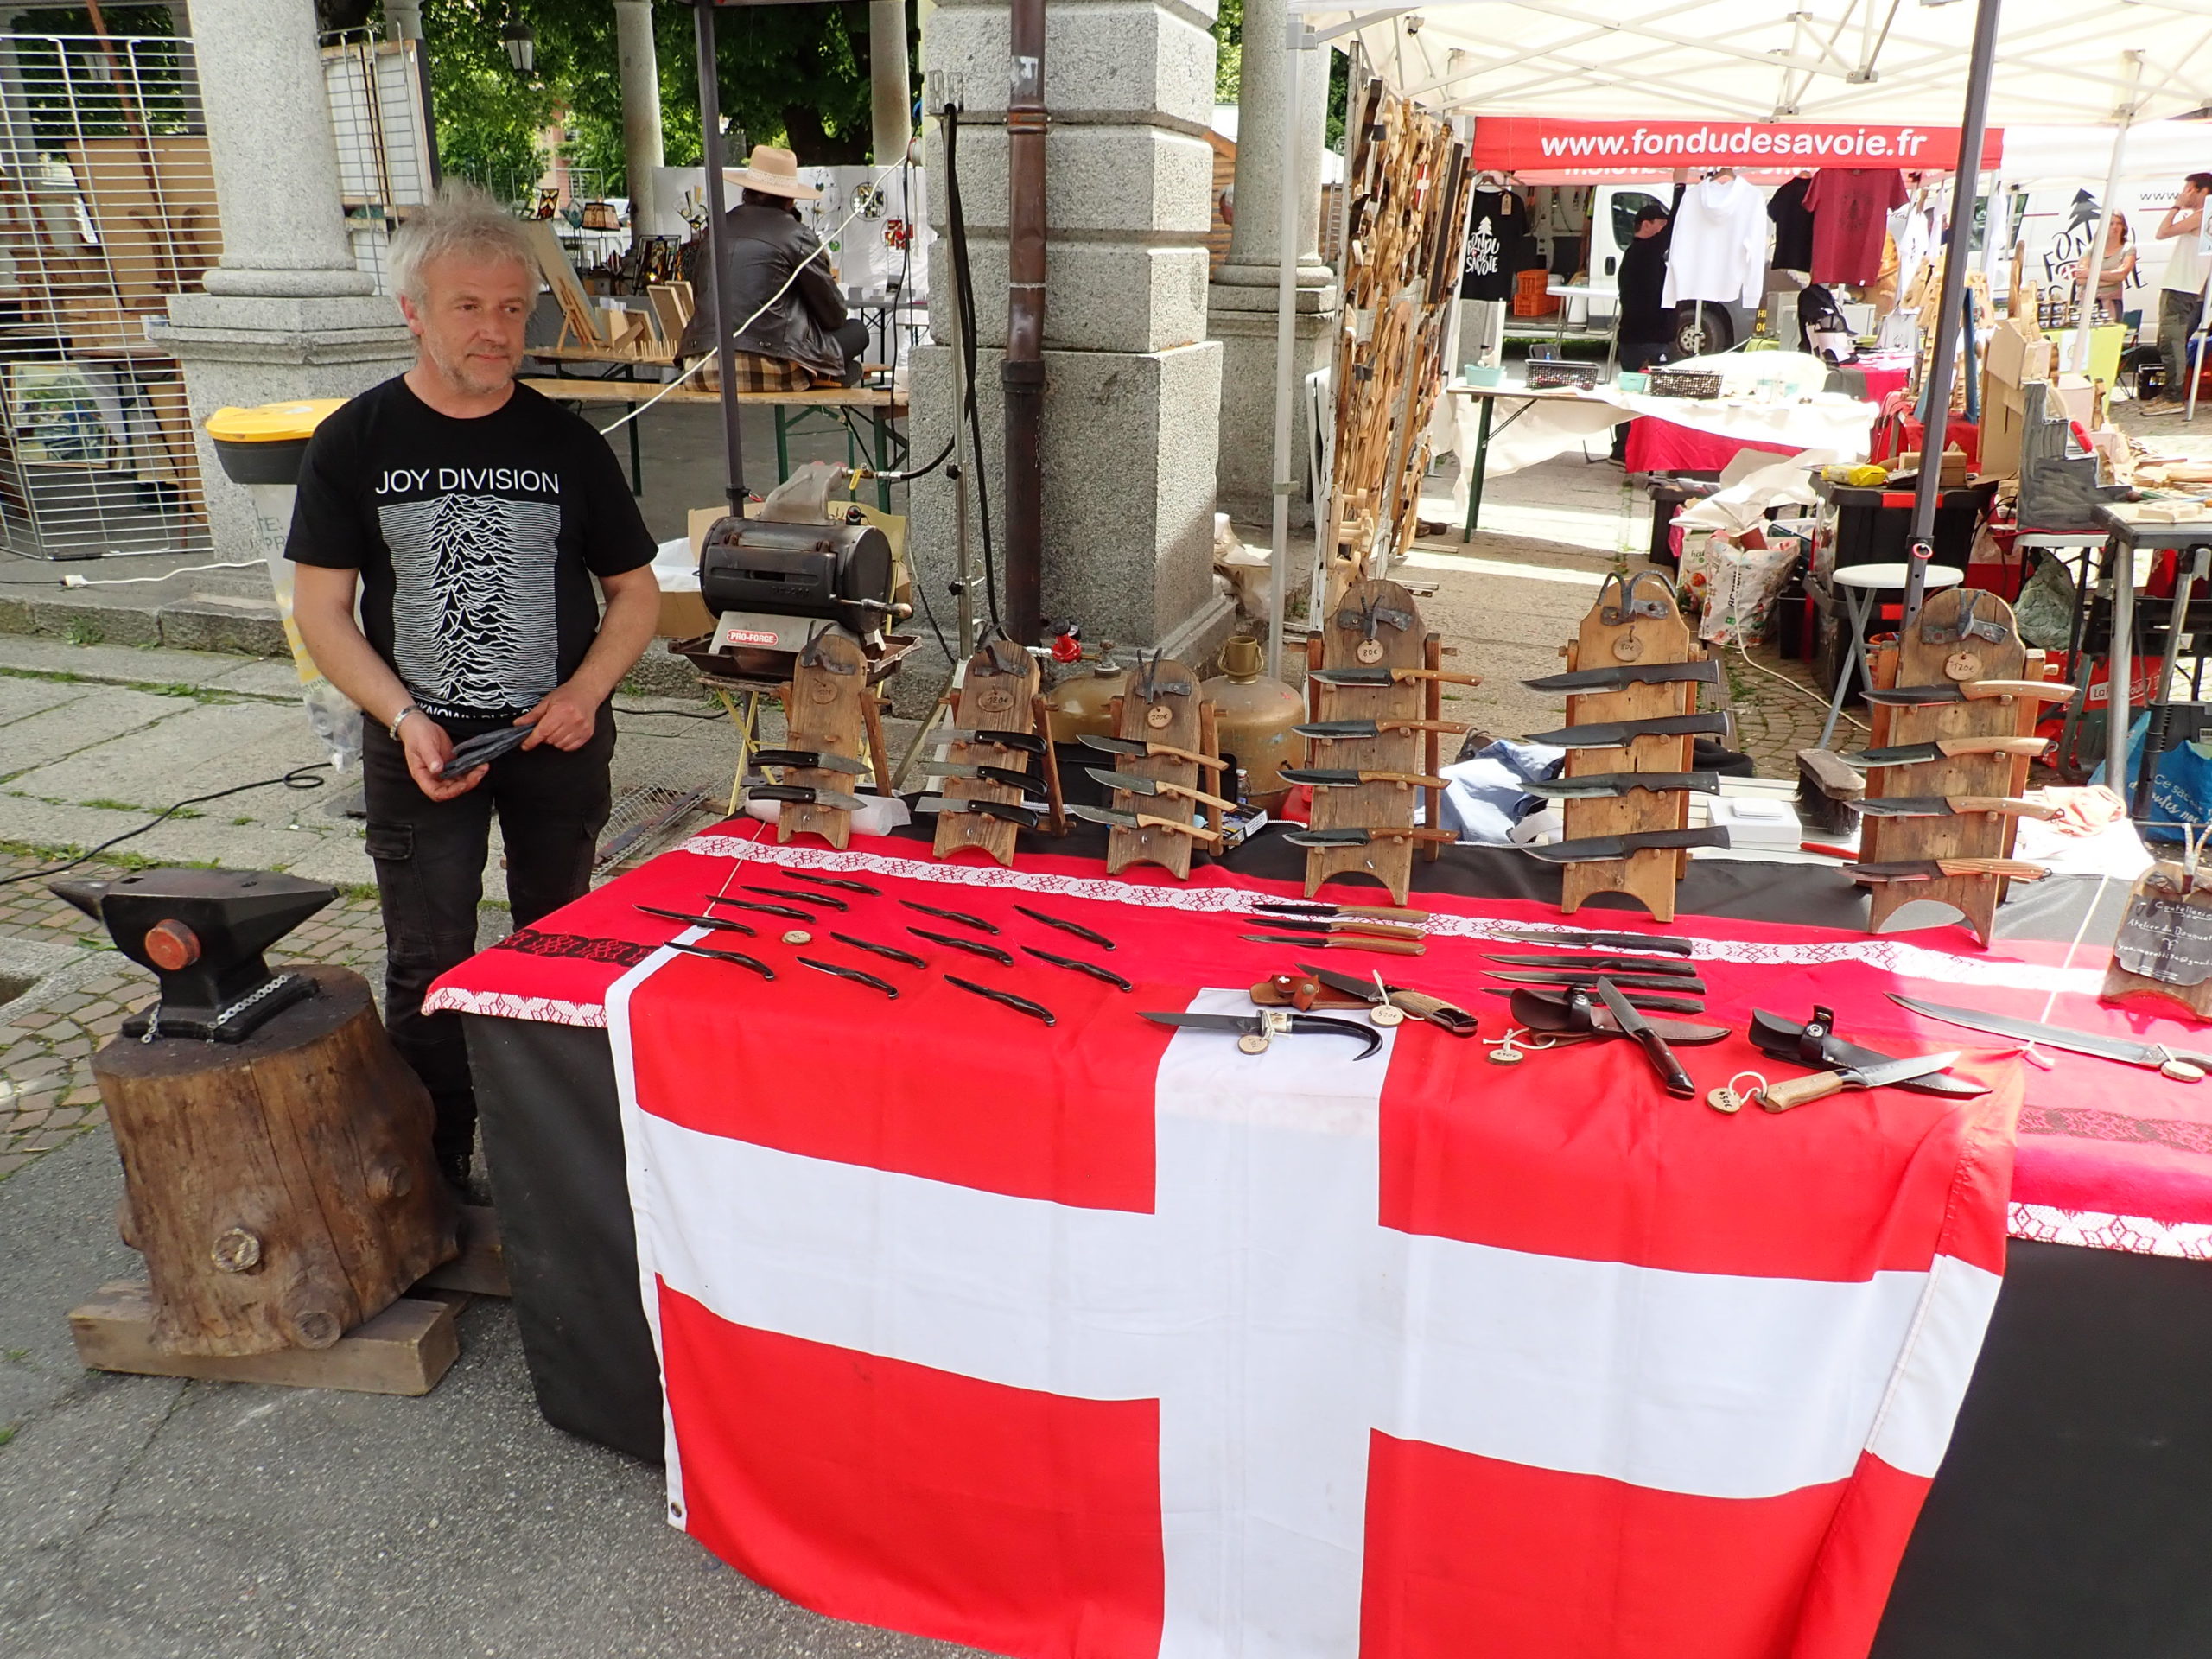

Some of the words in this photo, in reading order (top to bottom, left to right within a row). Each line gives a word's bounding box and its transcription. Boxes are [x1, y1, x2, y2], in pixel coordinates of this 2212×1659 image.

[1541, 126, 1927, 156] www.fondudesavoie.fr
[1467, 232, 1500, 256] FONDU
[1465, 255, 1499, 276] SAVOIE
[375, 468, 430, 495] JOY
[438, 467, 560, 495] DIVISION
[729, 632, 775, 644] PRO-FORGE
